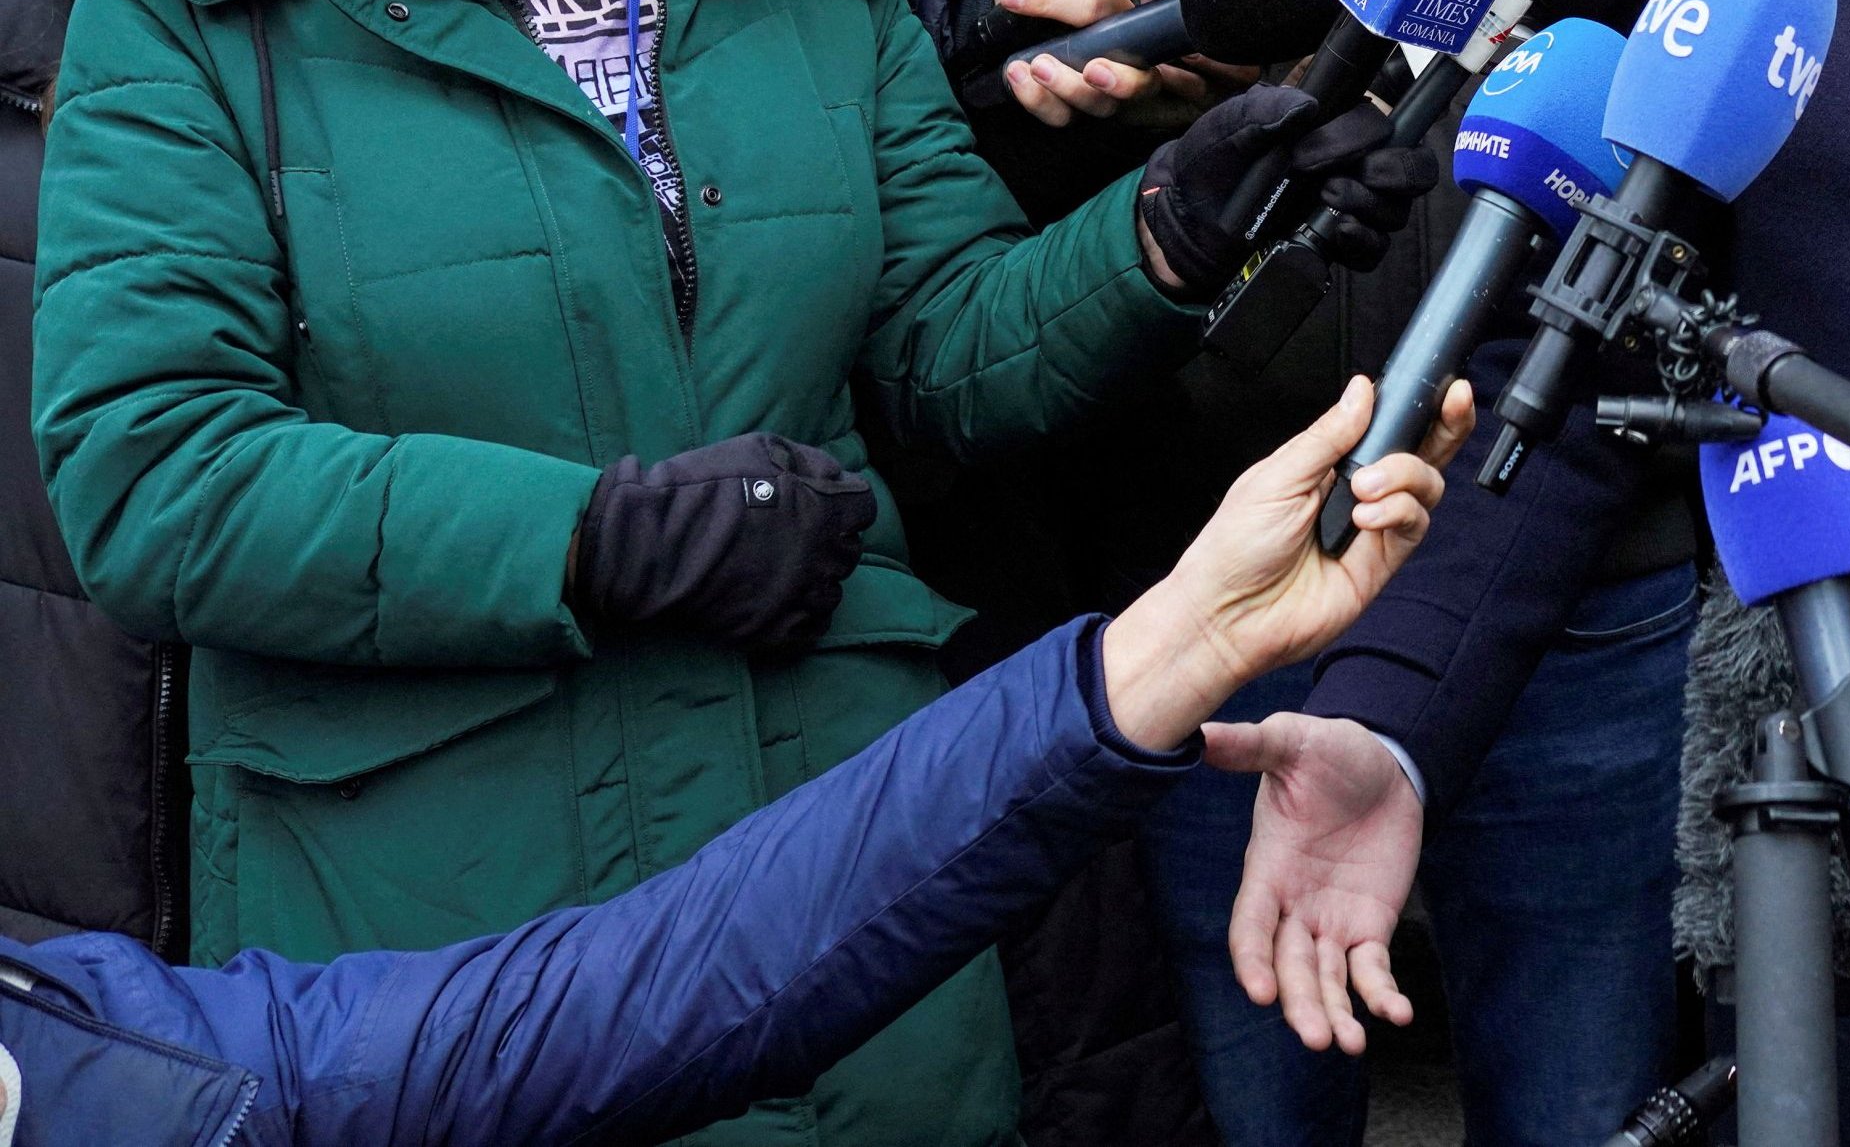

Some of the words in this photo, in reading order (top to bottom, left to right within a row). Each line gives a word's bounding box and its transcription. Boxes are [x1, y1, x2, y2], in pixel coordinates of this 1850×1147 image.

[1398, 19, 1456, 46] ROMÂNIA
[1498, 440, 1524, 481] SONY
[1729, 432, 1819, 494] AFP
